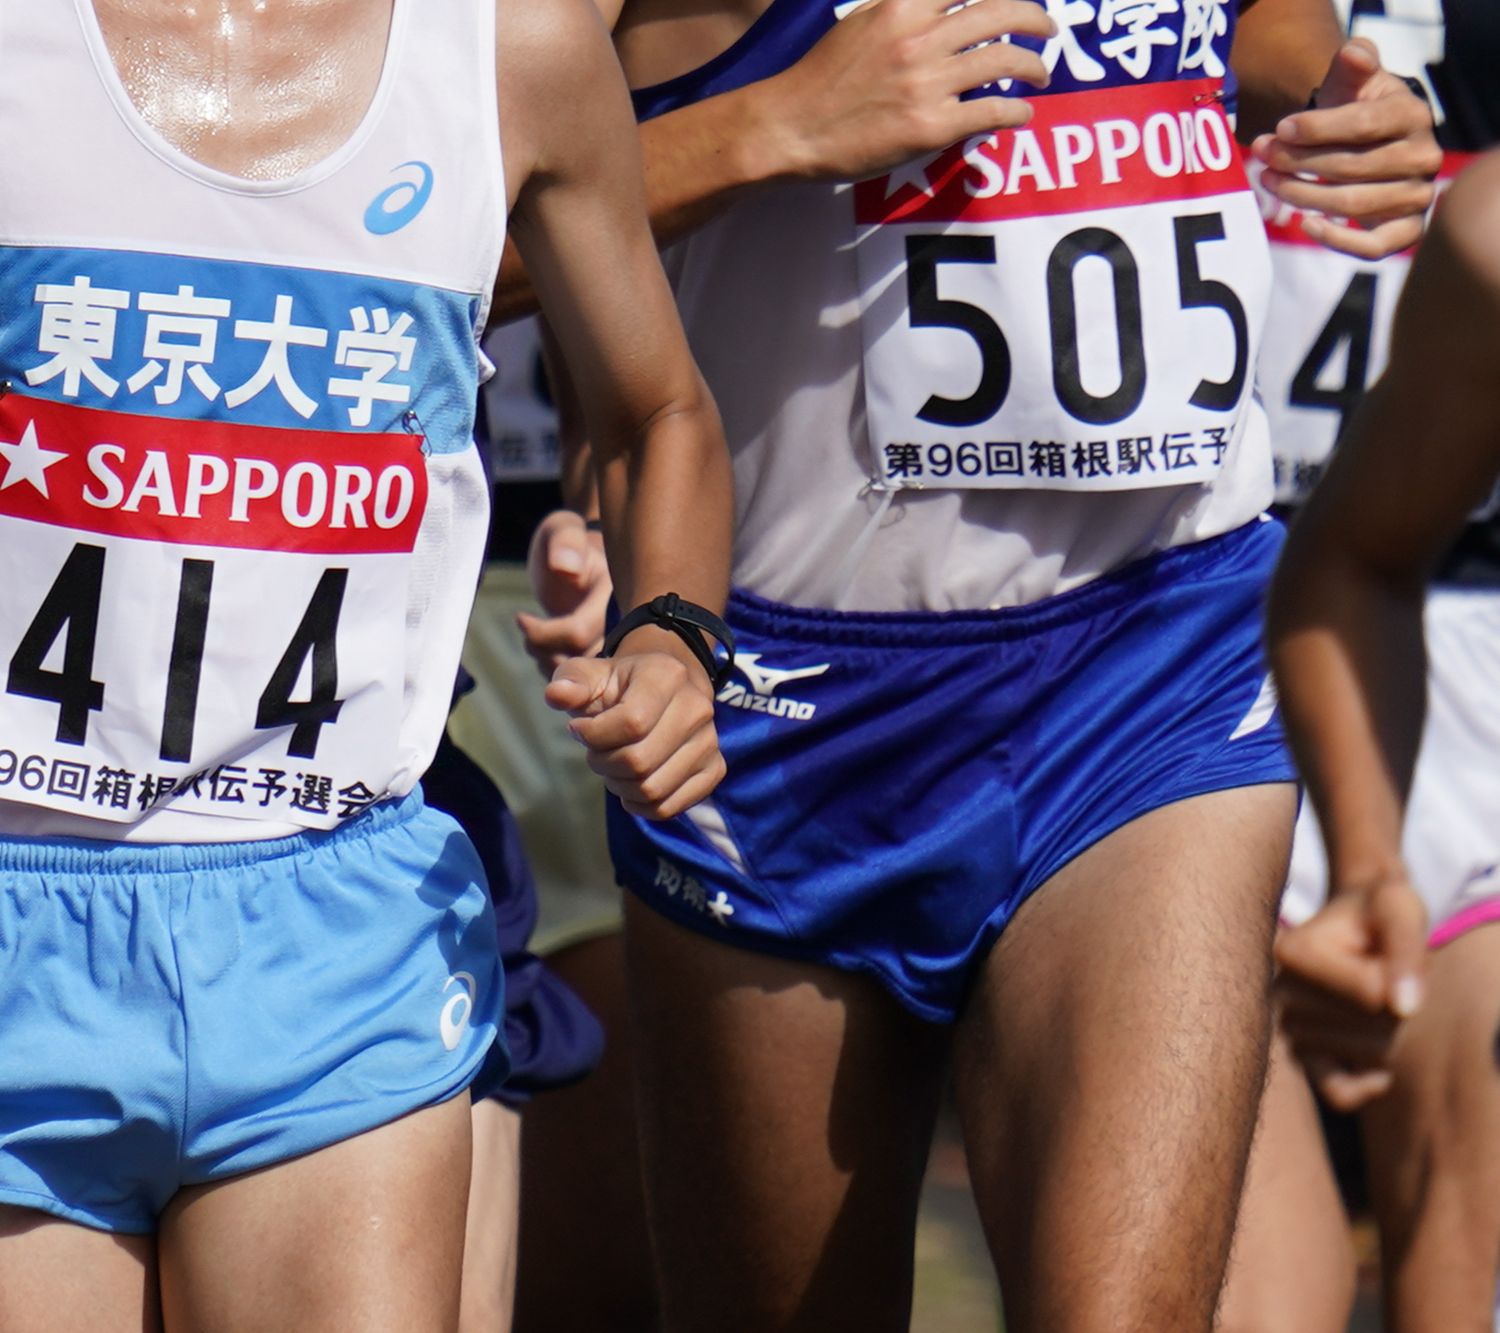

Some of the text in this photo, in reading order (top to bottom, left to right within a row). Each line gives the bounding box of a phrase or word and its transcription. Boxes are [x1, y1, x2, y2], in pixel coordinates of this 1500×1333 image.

[961, 106, 1234, 200] SAPPORO
[24, 275, 418, 426] 東京大学
[904, 212, 1250, 427] 505
[82, 444, 416, 531] SAPPORO
[5, 541, 351, 764] 414
